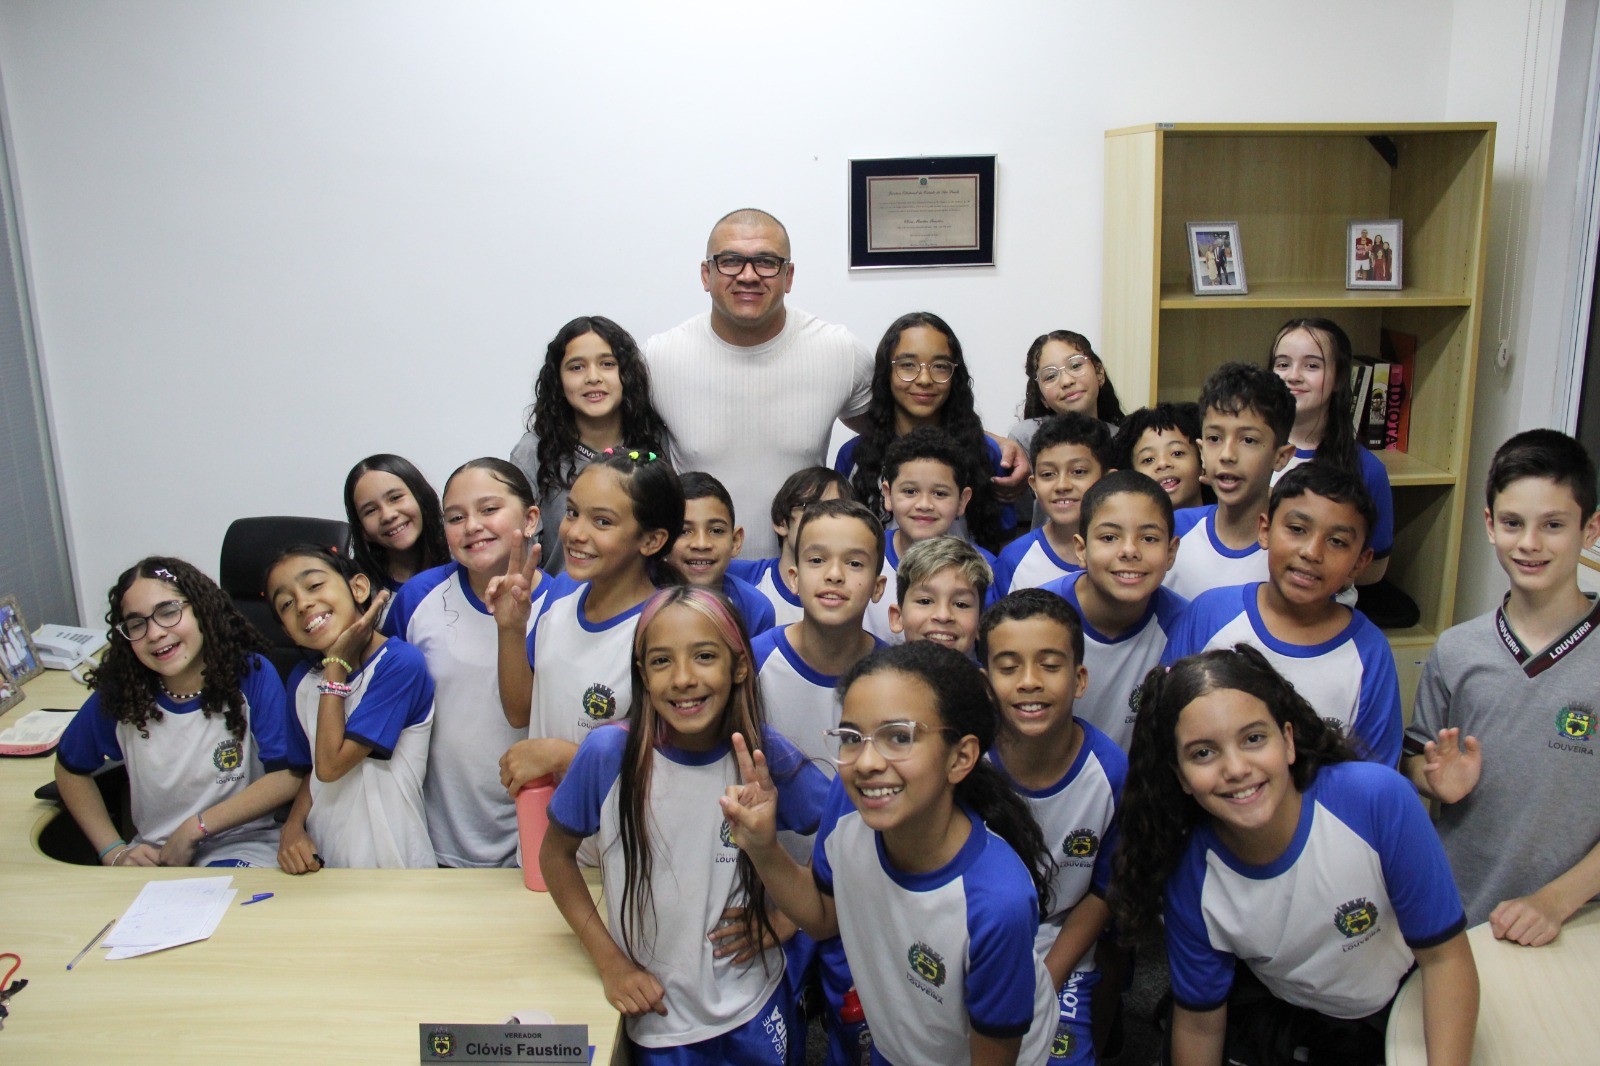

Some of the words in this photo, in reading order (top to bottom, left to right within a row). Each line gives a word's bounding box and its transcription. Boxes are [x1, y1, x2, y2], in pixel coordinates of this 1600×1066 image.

[1386, 383, 1402, 447] IDIOTA
[1498, 616, 1520, 656] LOUVEIRA
[1549, 621, 1592, 660] LOUVEIRA
[1548, 740, 1594, 756] LOUVEIRA
[762, 1015, 775, 1035] DE
[466, 1043, 513, 1056] Clóvis
[517, 1043, 582, 1056] Faustino
